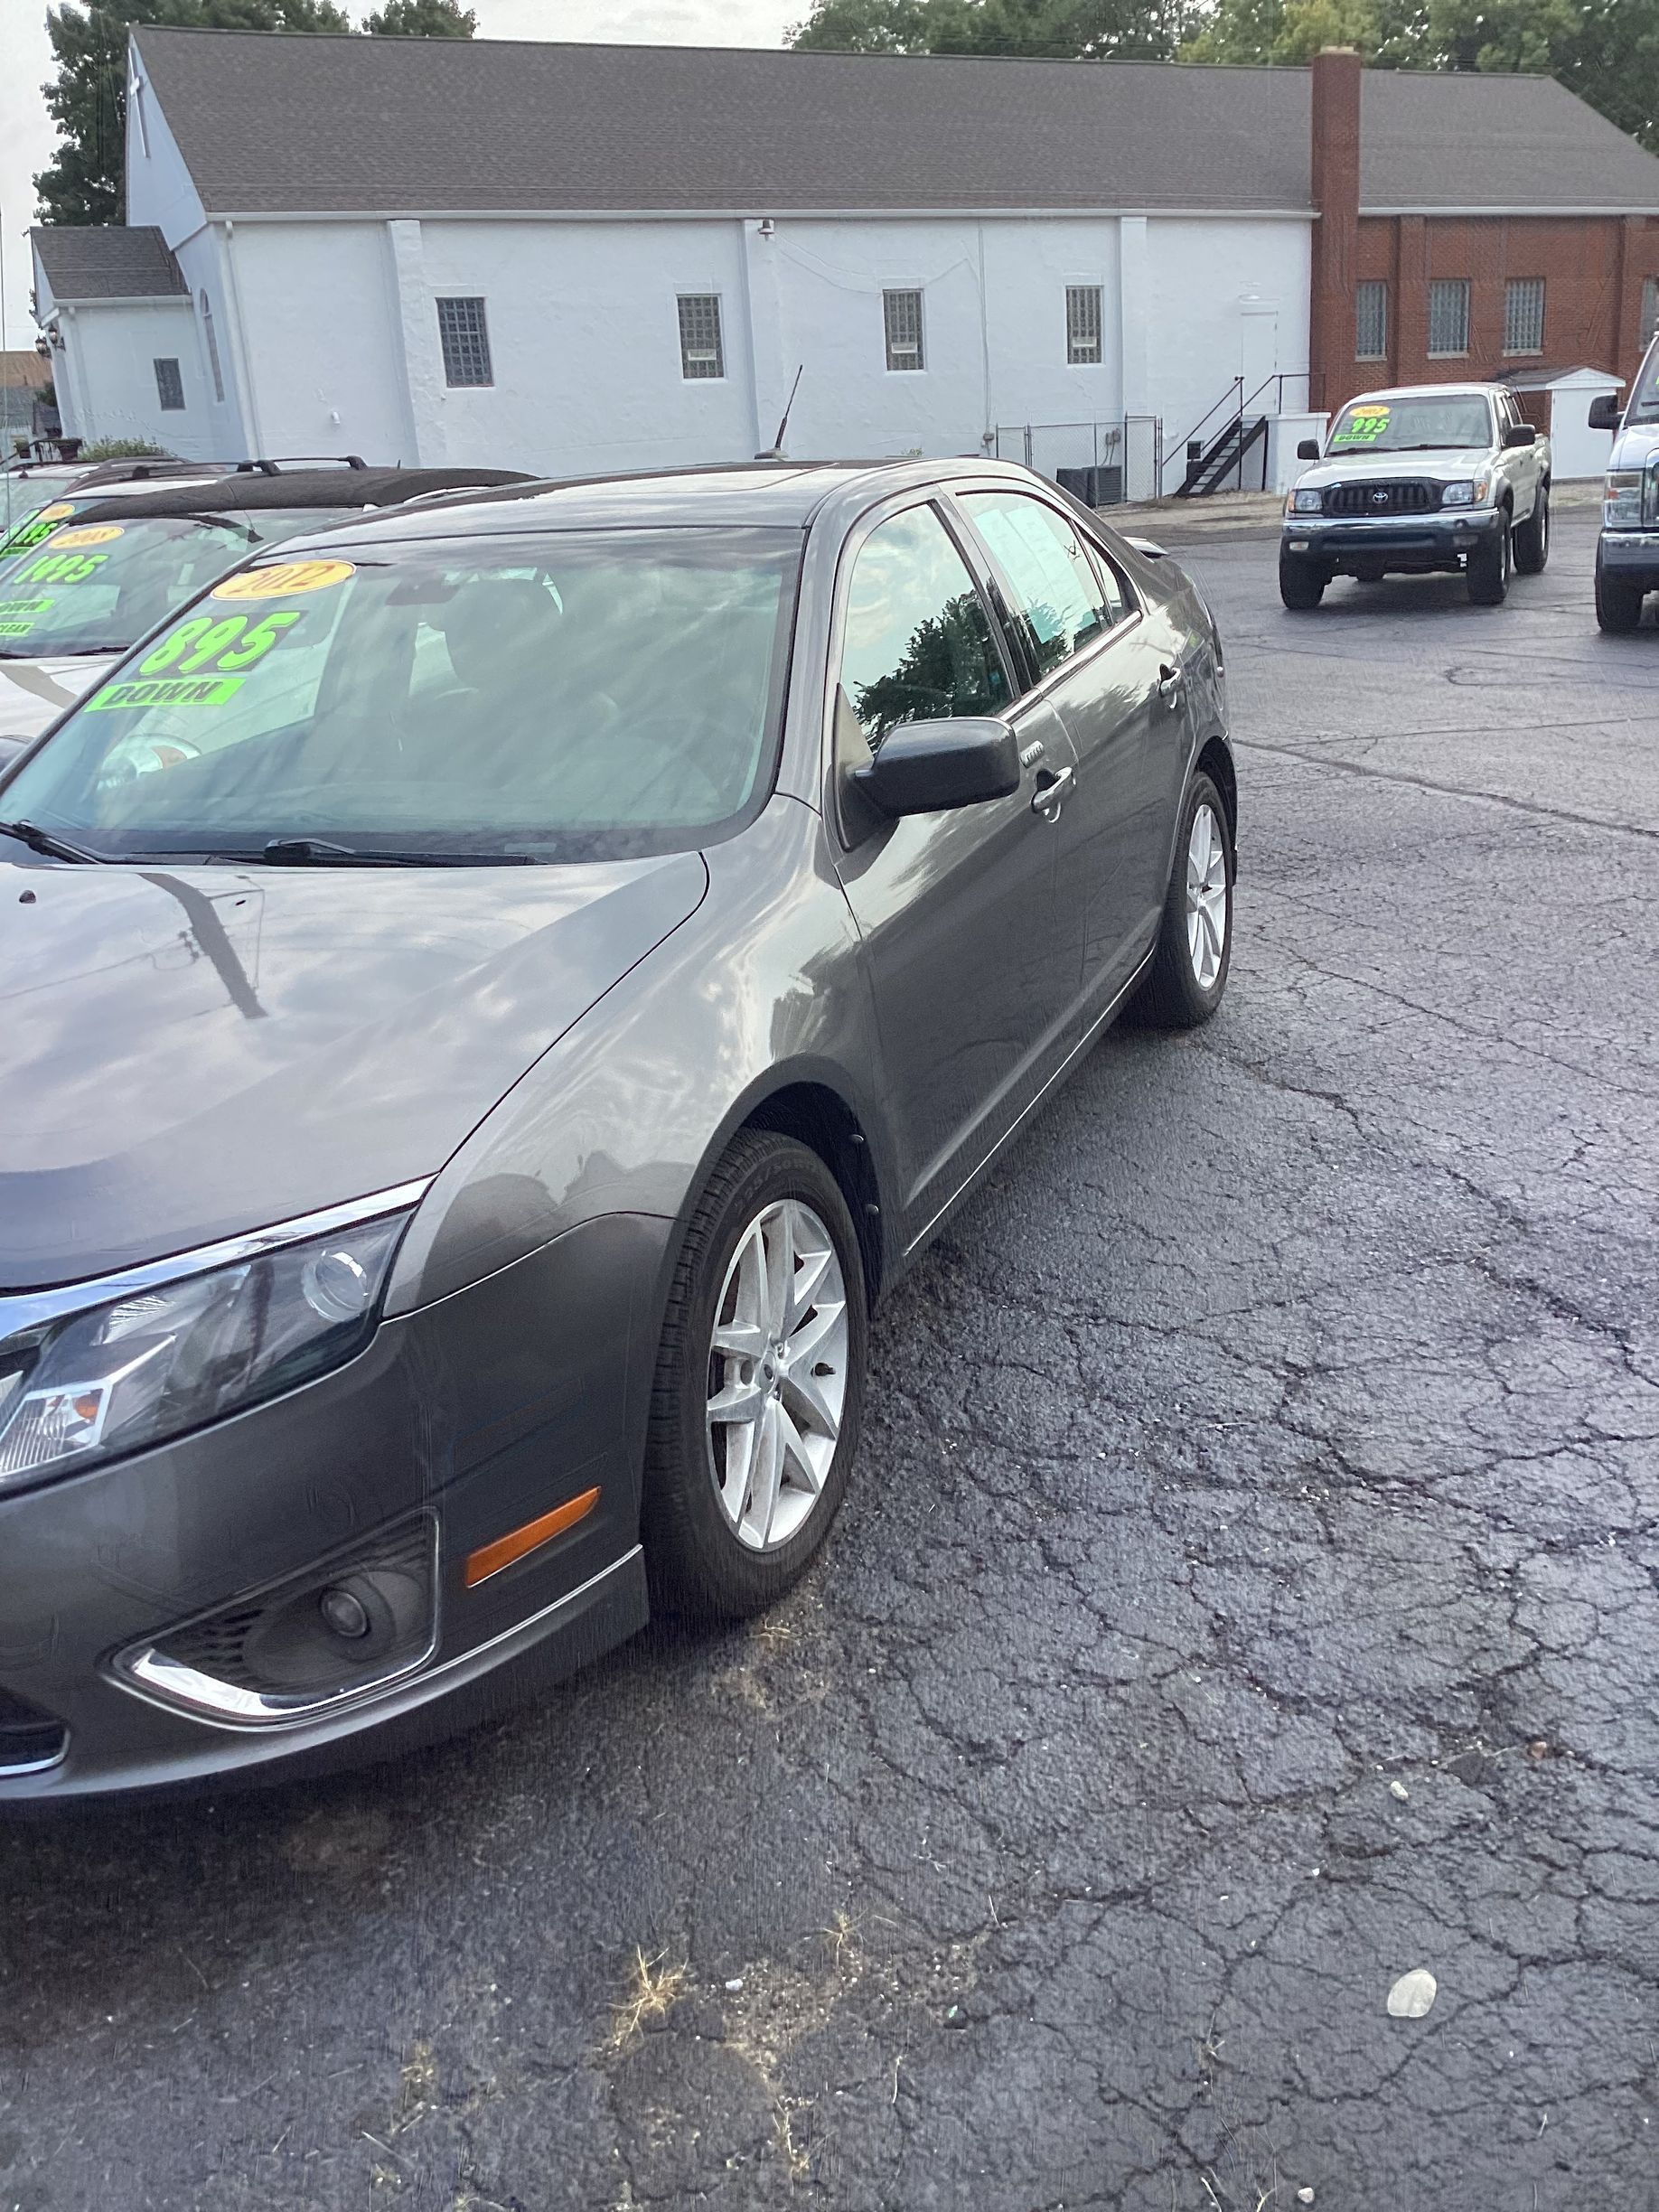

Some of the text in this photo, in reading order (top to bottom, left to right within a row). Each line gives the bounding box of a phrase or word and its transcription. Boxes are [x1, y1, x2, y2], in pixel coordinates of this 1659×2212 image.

[1351, 417, 1391, 434] 995
[14, 554, 108, 584] 1495
[226, 564, 337, 595] 2012
[139, 611, 301, 676] 895
[100, 680, 224, 708] DOWN
